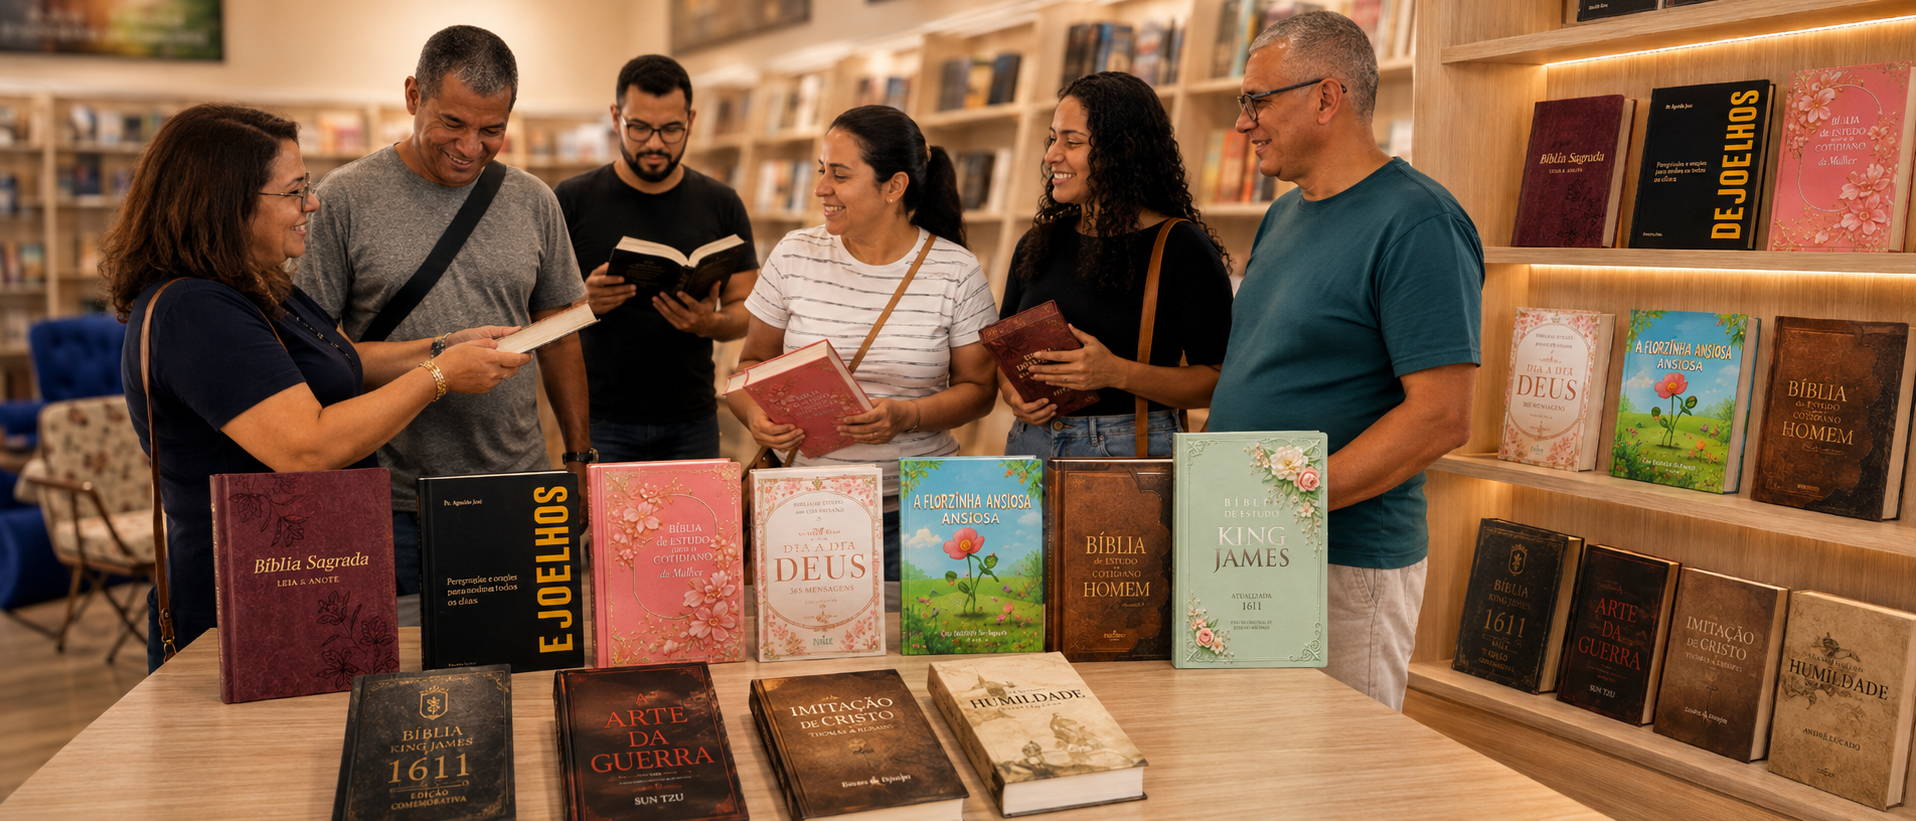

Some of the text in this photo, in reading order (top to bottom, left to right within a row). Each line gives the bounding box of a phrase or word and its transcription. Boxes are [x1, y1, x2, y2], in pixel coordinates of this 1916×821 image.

[1635, 339, 1732, 361] A FLORZINHA ANSIOSA
[1657, 358, 1703, 372] ANSIOSA
[1516, 374, 1578, 402] DEUS
[1788, 378, 1848, 403] BÍBLIA
[1781, 421, 1854, 446] HOMEM
[913, 491, 1031, 510] A FLORZINHA ANSIOSA
[941, 512, 1000, 525] ANSIOSA
[1224, 510, 1237, 518] DE
[669, 522, 703, 534] BÍBLIA
[1217, 525, 1286, 546] KING
[656, 535, 711, 546] de ESTUDO
[784, 541, 856, 553] DIA A DIA
[1086, 531, 1147, 555] BÍBLIA
[254, 551, 369, 575] Bíblia Sagrada
[653, 552, 713, 565] COTIDIANO
[774, 553, 866, 582] DEUS
[1213, 547, 1290, 573] JAMES
[277, 579, 298, 588] LEIA
[308, 575, 341, 585] ANOTE
[804, 585, 855, 594] MENSAGENS
[1083, 581, 1151, 598] HOMEM
[1494, 577, 1528, 598] BÍBLIA
[1242, 601, 1262, 611] 1611
[1594, 597, 1638, 624] ARTE
[1484, 608, 1525, 638] 1611
[1601, 620, 1621, 641] DA
[1686, 616, 1754, 645] IMITAÇÃO
[1578, 636, 1641, 671] GUERRA
[1700, 638, 1747, 660] CRISTO
[1789, 658, 1889, 701] HUMILDADE
[636, 692, 649, 705] A
[789, 696, 894, 717] IMITAÇÃO
[970, 689, 1085, 709] HUMILDADE
[604, 706, 688, 728] ARTE
[800, 710, 895, 730] DE CRISTO
[402, 725, 463, 742] BÍBLIA
[628, 729, 670, 748] DA
[390, 737, 474, 754] KING JAMES
[387, 753, 470, 784] 1611
[591, 746, 715, 773] GUERRA
[390, 795, 467, 811] COMEMORATIVA
[634, 793, 684, 806] SUN TZU
